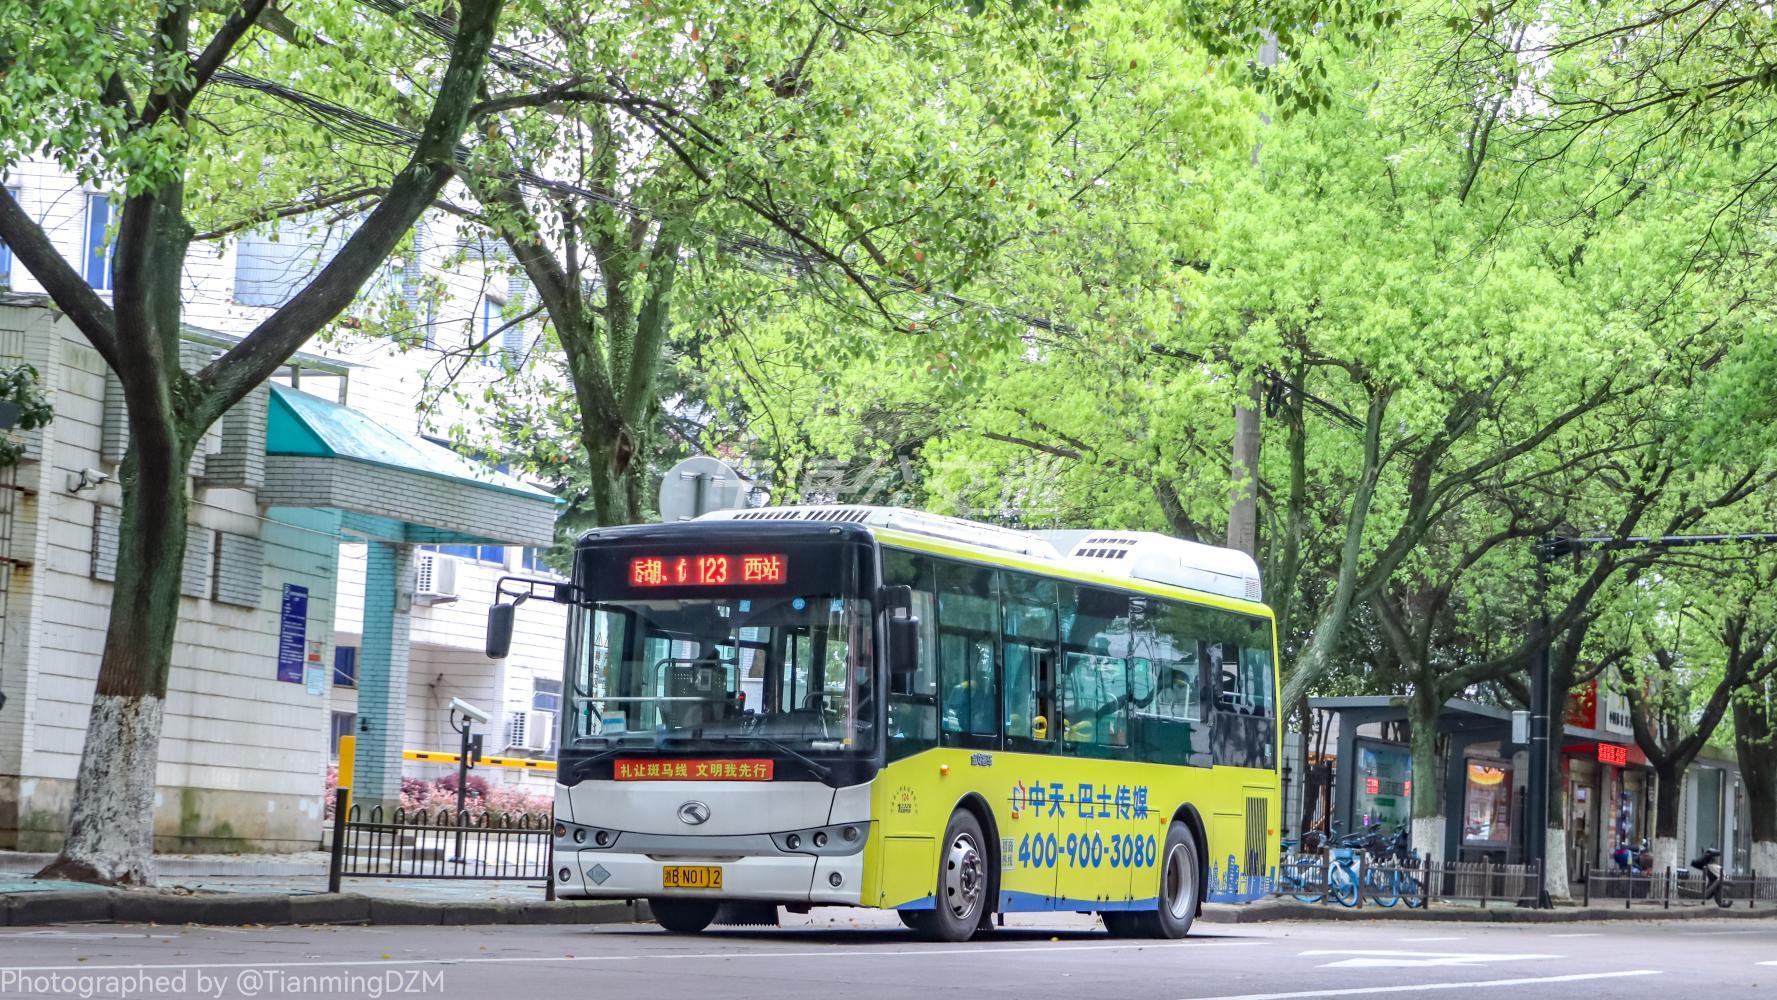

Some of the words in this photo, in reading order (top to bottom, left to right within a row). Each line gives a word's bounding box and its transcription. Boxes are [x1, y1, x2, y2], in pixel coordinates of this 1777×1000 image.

[699, 557, 727, 583] 123
[744, 556, 780, 581] 西站
[620, 763, 688, 778] 礼让斑马线
[696, 763, 767, 778] 文明我先行
[1018, 831, 1157, 869] 400-900-3080
